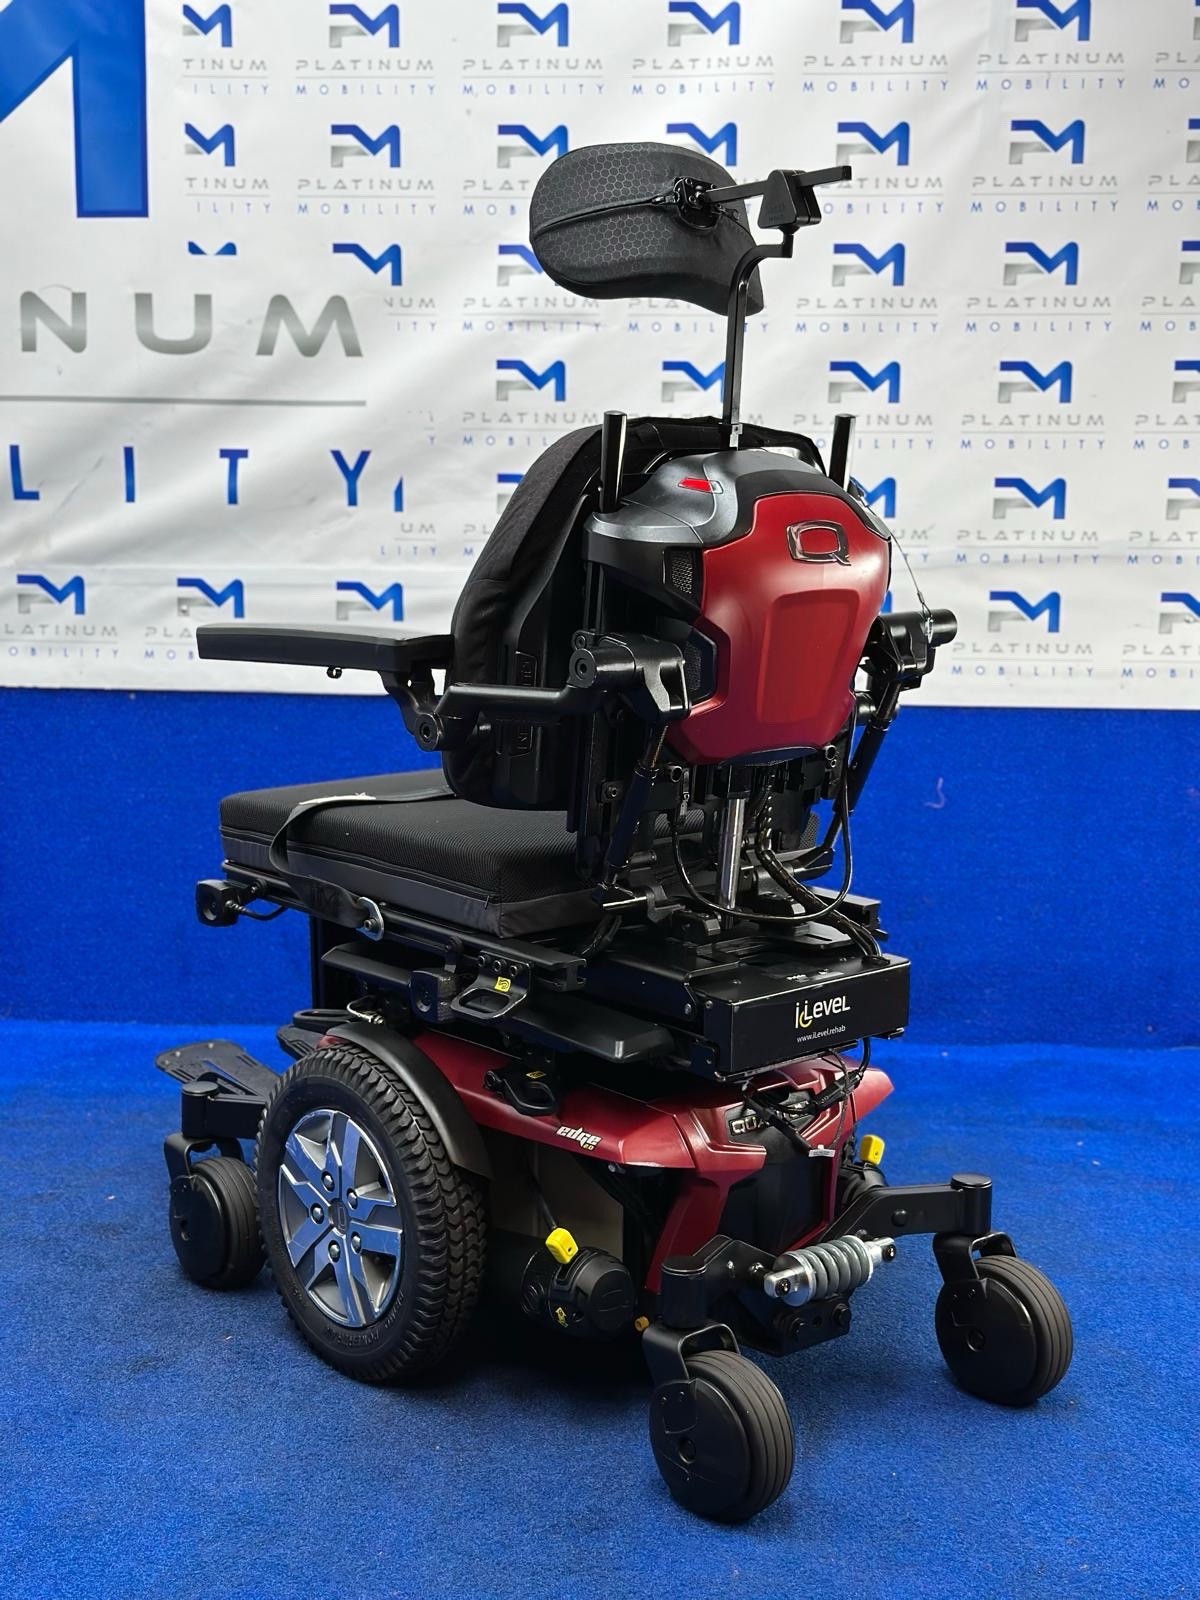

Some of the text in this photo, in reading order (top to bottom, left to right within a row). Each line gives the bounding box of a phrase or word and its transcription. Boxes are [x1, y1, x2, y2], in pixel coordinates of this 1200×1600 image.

[328, 3, 400, 49] PM
[496, 1, 570, 48] PM
[667, 1, 742, 47] PM
[839, 0, 915, 44] PM
[1014, 0, 1092, 42] PM
[296, 59, 433, 71] PLATINUM
[463, 59, 602, 70] PLATINUM
[632, 57, 774, 69] PLATINUM
[804, 54, 948, 67] PLATINUM
[978, 53, 1124, 65] PLATINUM
[296, 84, 435, 95] MOBILITY
[463, 84, 604, 95] MOBILITY
[632, 81, 774, 95] MOBILITY
[802, 80, 948, 92] MOBILITY
[976, 78, 1125, 89] MOBILITY
[330, 123, 402, 169] PM
[836, 121, 911, 167] PM
[1008, 118, 1086, 165] PM
[298, 179, 434, 190] PLATINUM
[972, 176, 1118, 187] PLATINUM
[298, 203, 435, 215] MOBILITY
[970, 200, 1118, 213] MOBILITY
[832, 242, 906, 287] PM
[1003, 240, 1080, 286] PM
[463, 297, 600, 309] PLATINUM
[797, 297, 937, 308] PLATINUM
[967, 297, 1111, 308] PLATINUM
[463, 320, 601, 332] MOBILITY
[628, 322, 768, 333] MOBILTY
[795, 322, 938, 332] MOBILITY
[966, 321, 1111, 332] MOBILITY
[495, 358, 567, 403] PM
[828, 360, 902, 404] PM
[997, 360, 1073, 404] PM
[462, 412, 600, 424] PLATINUM
[962, 414, 1104, 426] PLATINUM
[960, 439, 1105, 449] MOBILITY
[992, 477, 1067, 520] PM
[957, 530, 1098, 541] PLATINUM
[787, 521, 851, 566] Q
[955, 554, 1099, 565] MOBILITY
[17, 575, 86, 616] PM
[987, 590, 1062, 634] PM
[953, 643, 1092, 654] PLATINUM
[951, 666, 1093, 677] MOBILITY
[556, 1126, 602, 1148] edge
